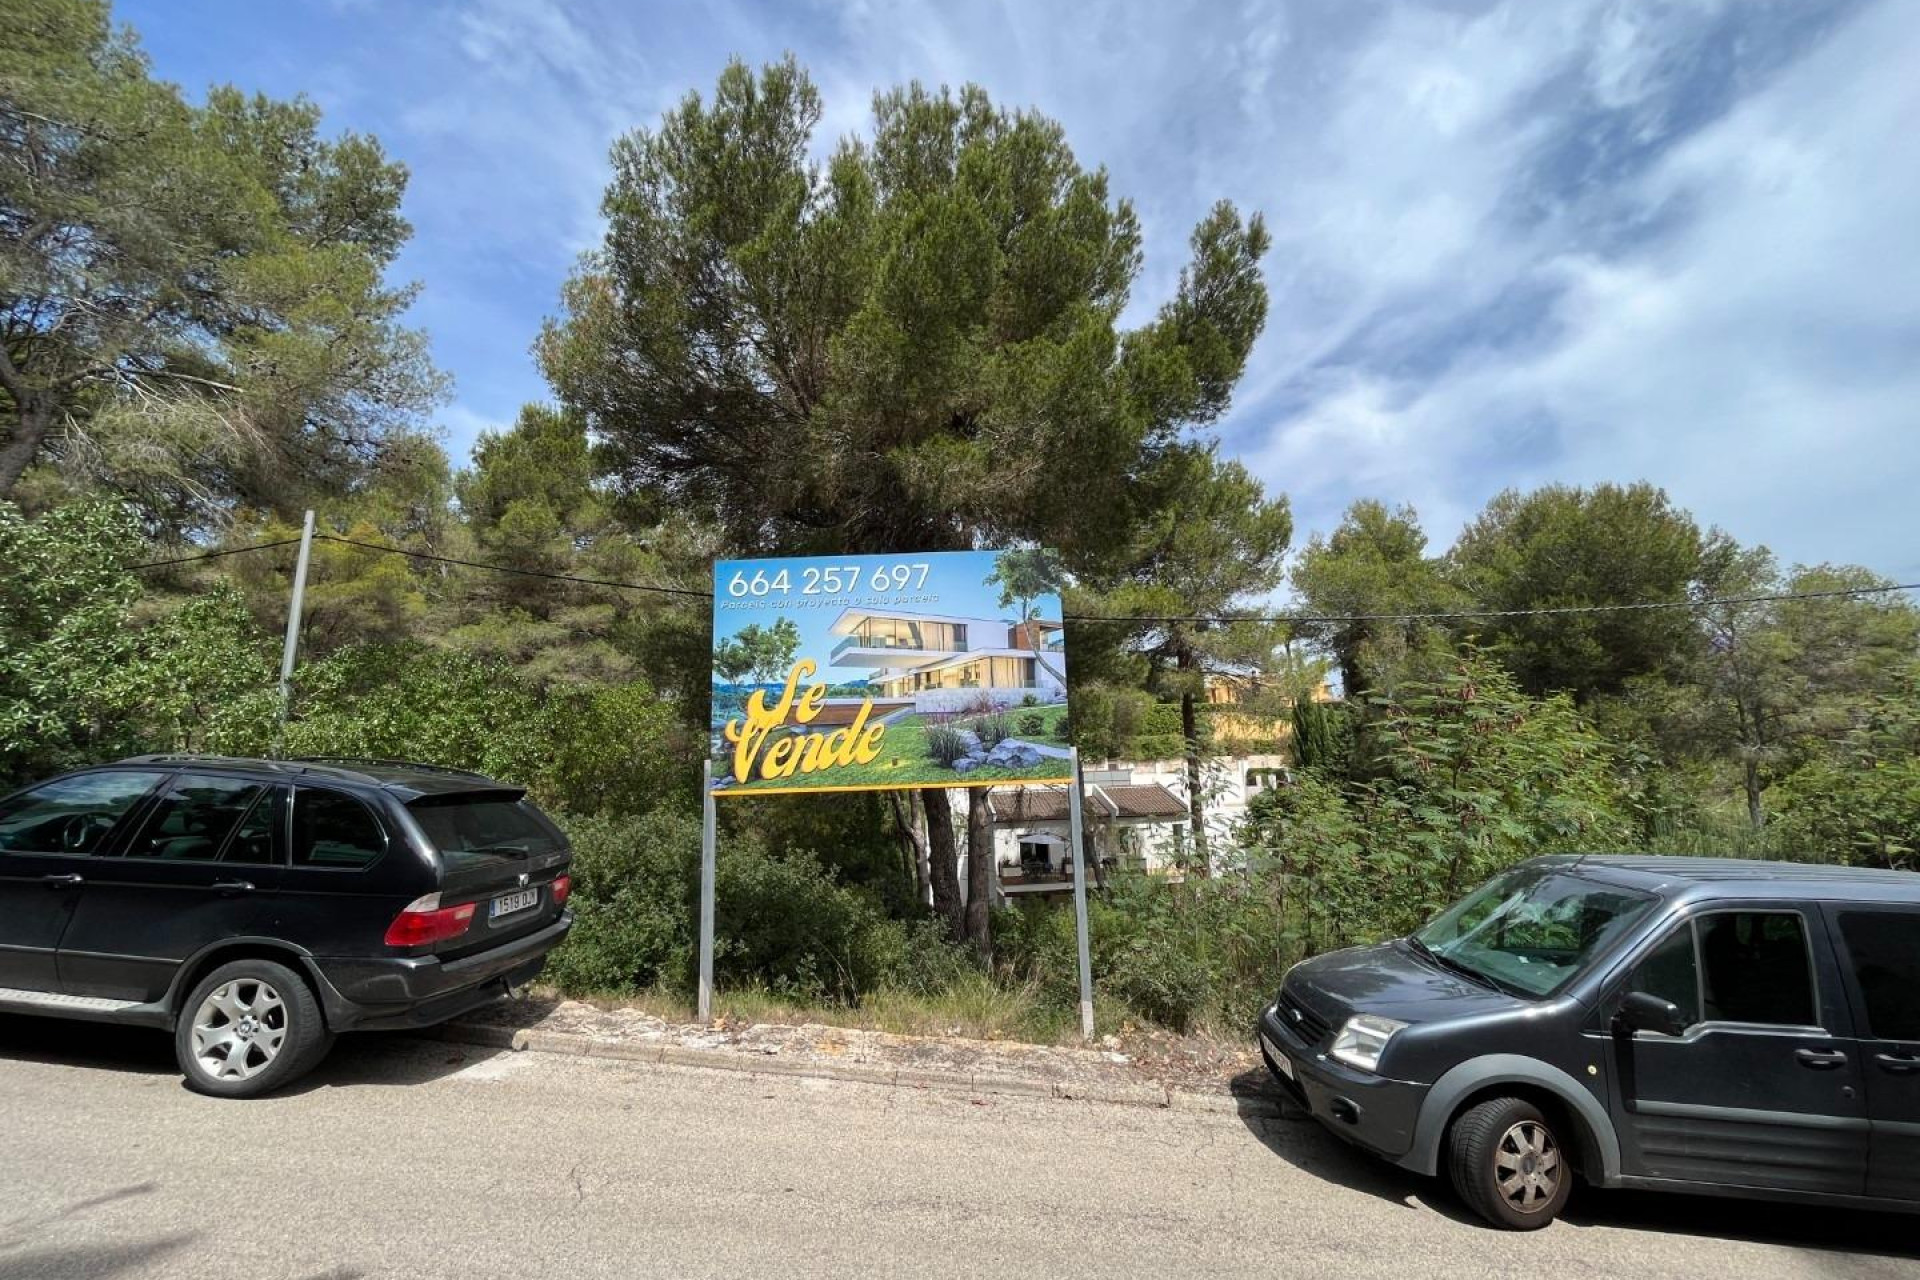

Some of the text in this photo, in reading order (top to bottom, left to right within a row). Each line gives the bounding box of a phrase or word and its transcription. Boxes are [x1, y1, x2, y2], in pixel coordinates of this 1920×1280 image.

[729, 564, 929, 597] 664 257 697
[748, 659, 826, 727] Se
[725, 696, 885, 784] Vende
